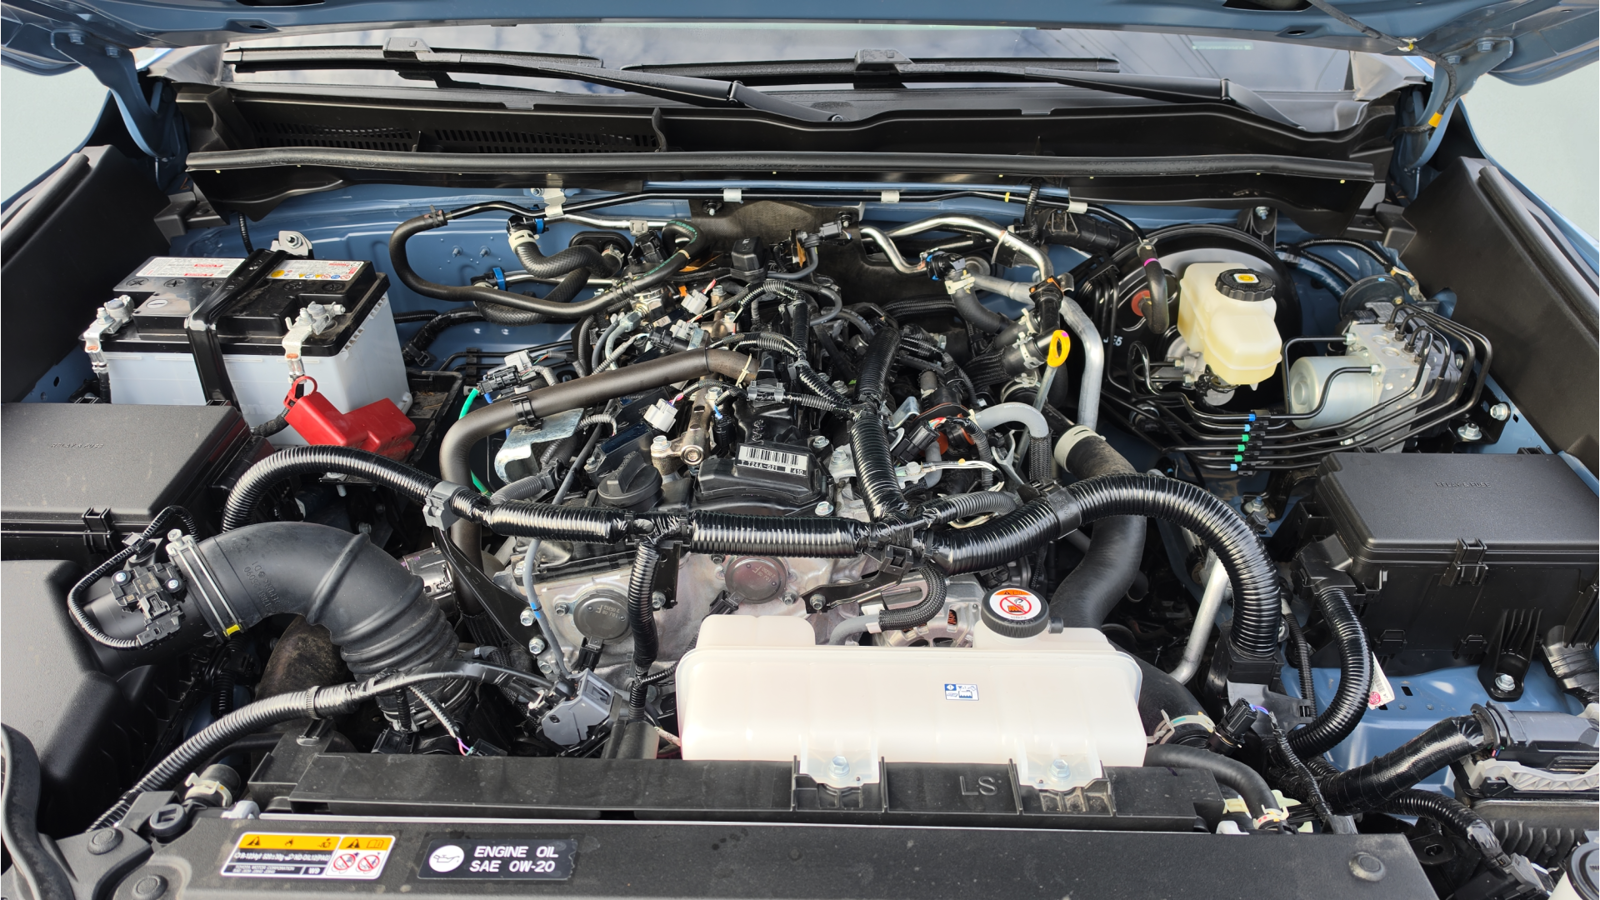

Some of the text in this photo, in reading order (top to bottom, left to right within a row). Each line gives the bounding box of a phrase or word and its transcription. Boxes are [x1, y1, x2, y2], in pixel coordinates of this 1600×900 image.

[960, 776, 997, 795] LS
[474, 846, 559, 858] ENGINE OIL
[469, 860, 556, 872] SAE 0W-20
